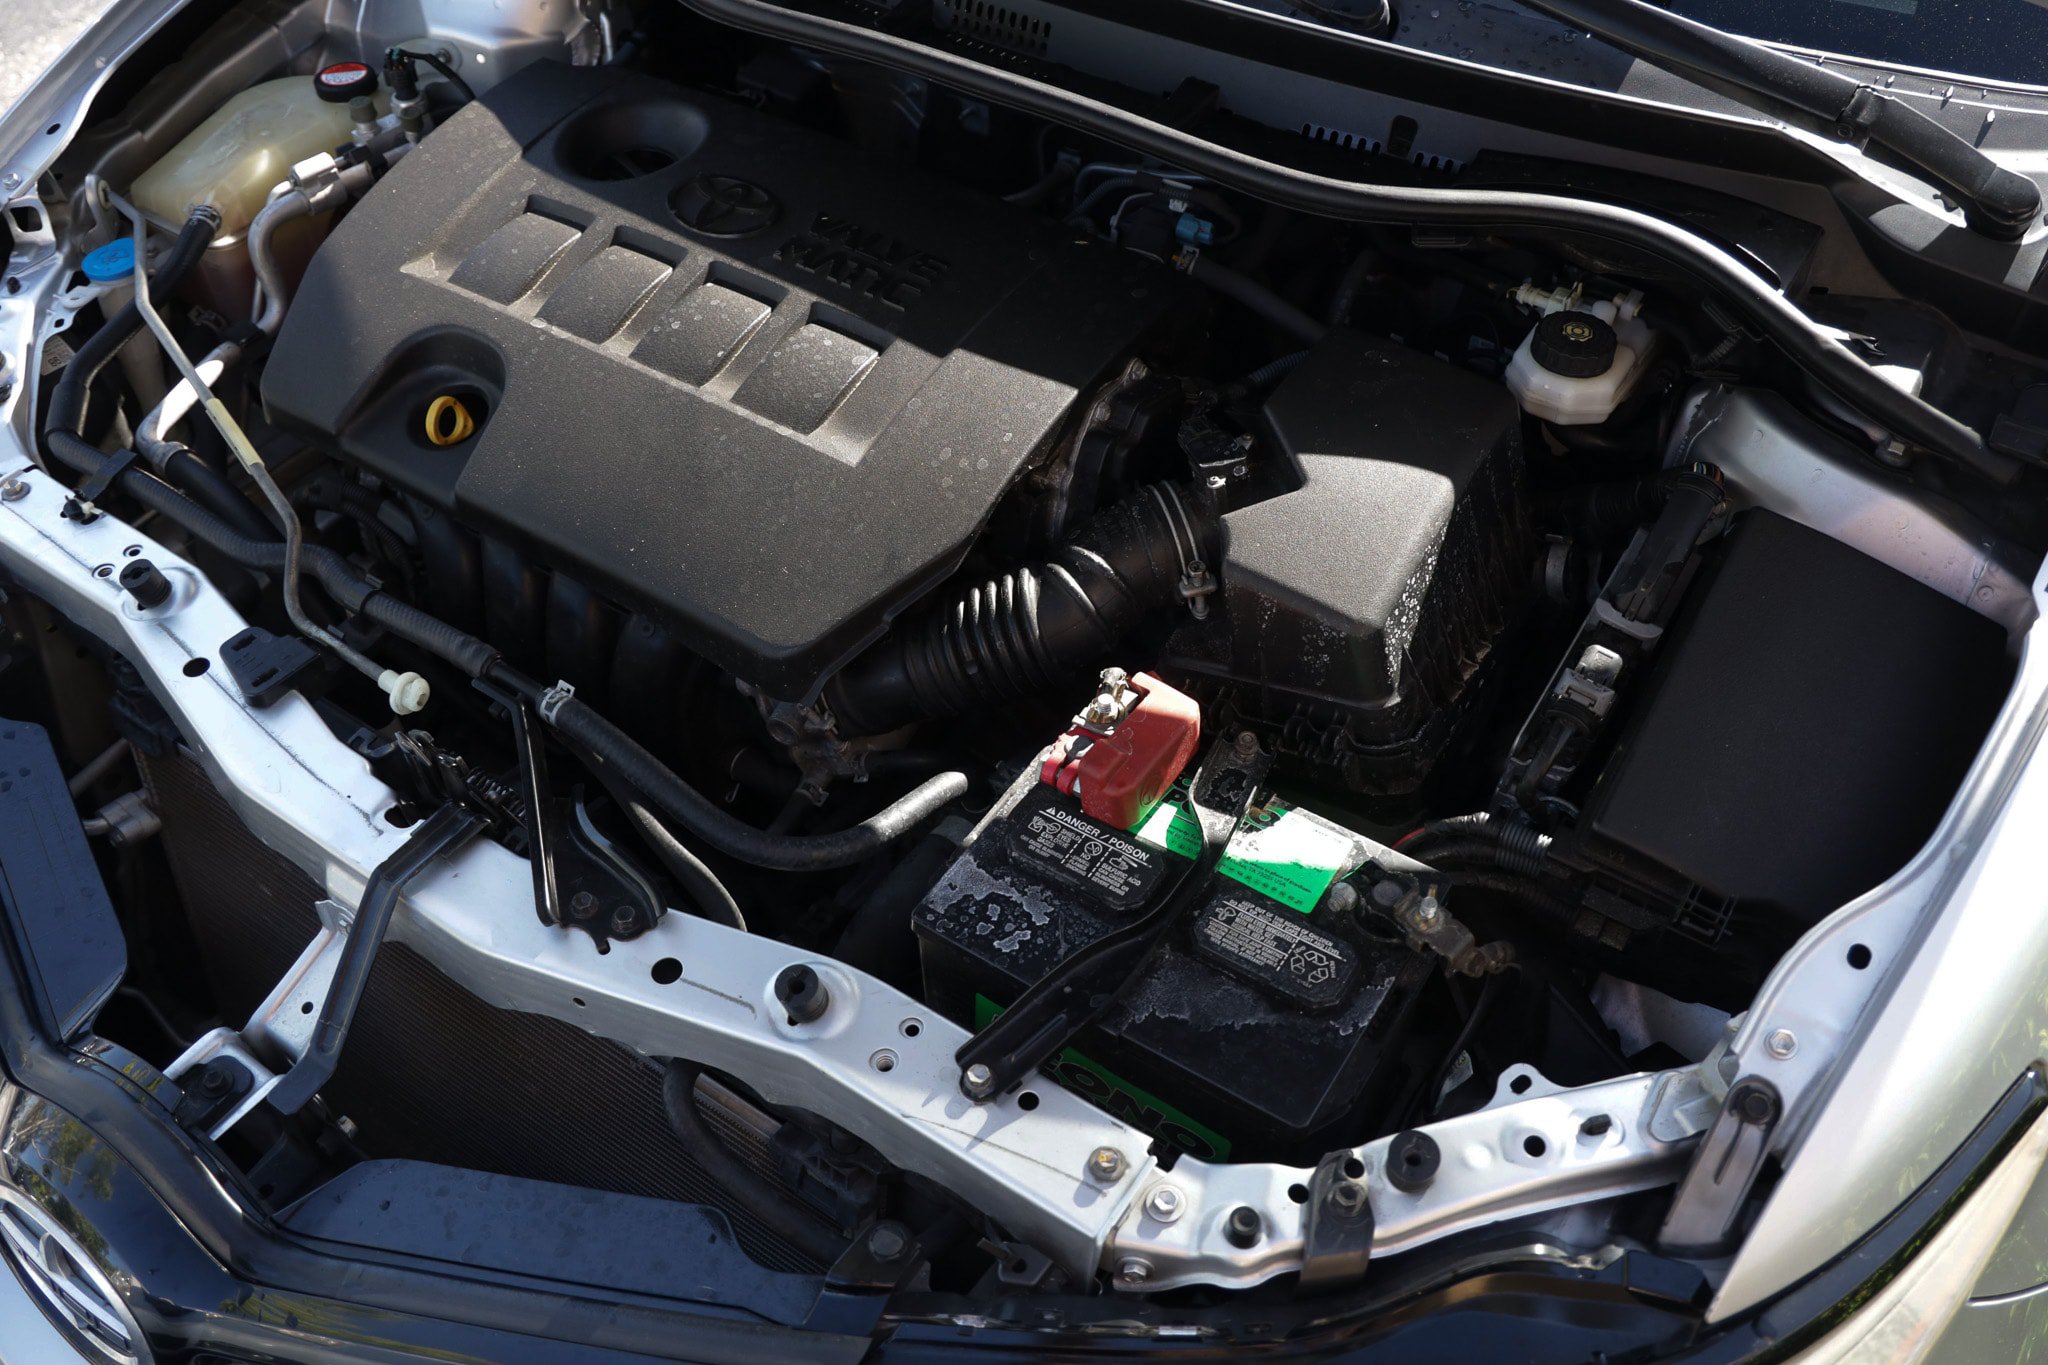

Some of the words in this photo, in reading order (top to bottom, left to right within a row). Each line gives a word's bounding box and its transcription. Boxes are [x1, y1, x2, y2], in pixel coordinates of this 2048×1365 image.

[1056, 810, 1101, 837] DANGER
[1099, 833, 1110, 841] /
[1108, 837, 1150, 862] POISON
[1056, 833, 1072, 843] EYES
[1060, 828, 1080, 841] SHIELD
[1080, 852, 1091, 860] NO
[1101, 863, 1128, 879] SULFURIC
[1127, 876, 1141, 886] ACID
